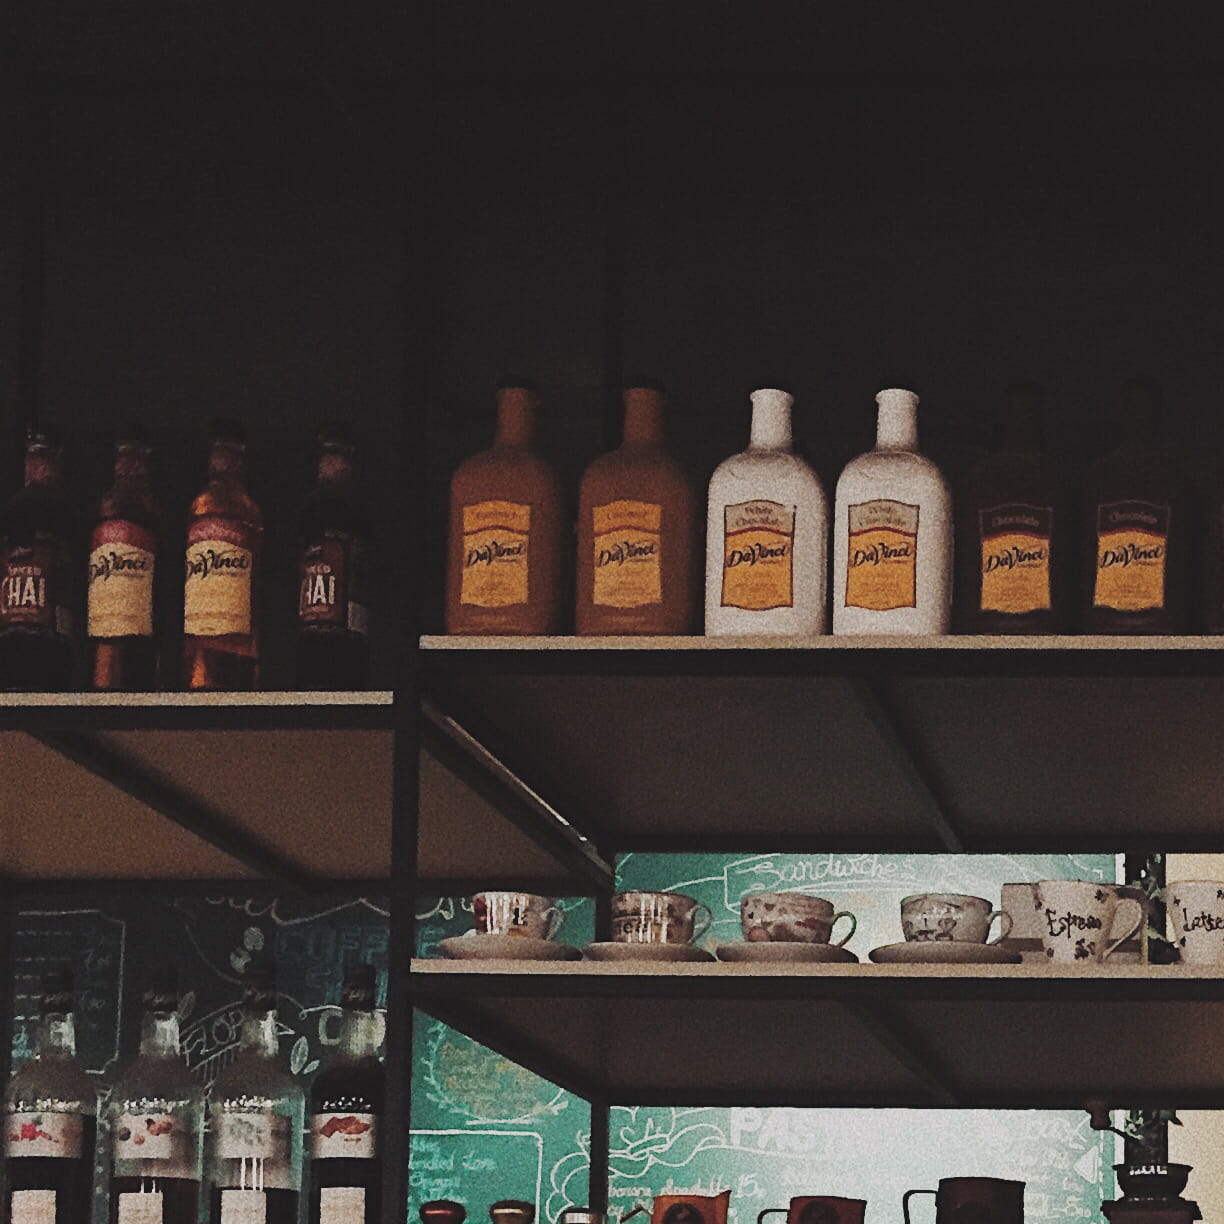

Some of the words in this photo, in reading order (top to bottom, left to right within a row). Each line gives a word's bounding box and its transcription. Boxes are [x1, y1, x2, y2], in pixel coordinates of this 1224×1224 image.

[187, 550, 249, 580] DaVinci
[466, 541, 524, 567] DaVinci
[599, 541, 656, 567] DaVinci
[728, 543, 786, 567] DaVinci
[854, 543, 911, 567] DaVinci
[984, 547, 1044, 572] DaVinci
[1100, 544, 1162, 568] DaVinci
